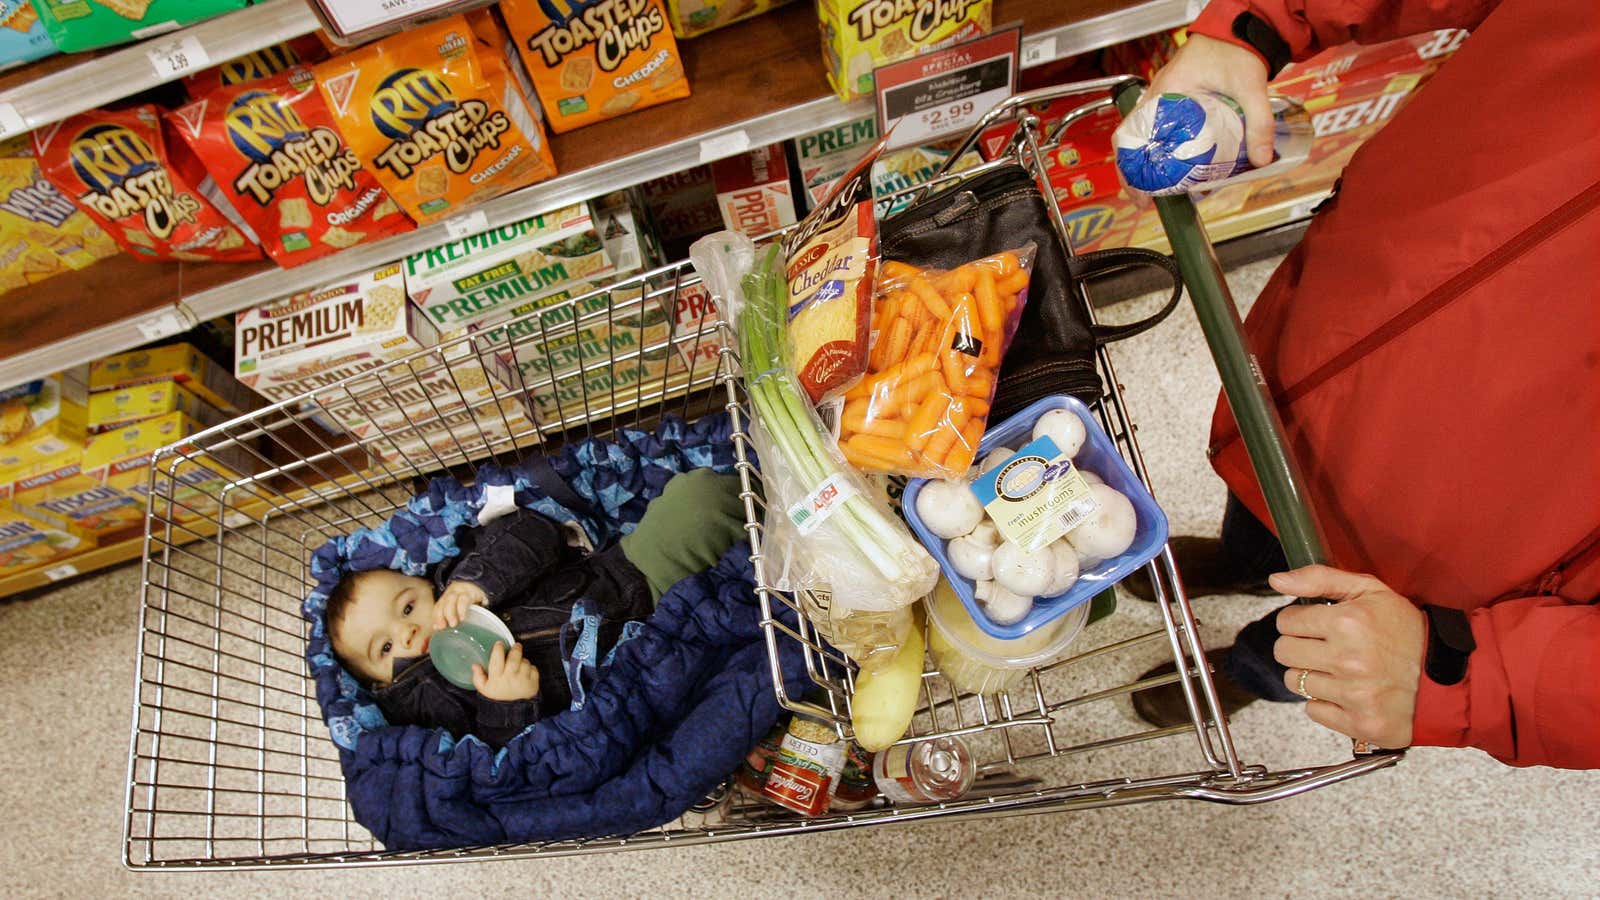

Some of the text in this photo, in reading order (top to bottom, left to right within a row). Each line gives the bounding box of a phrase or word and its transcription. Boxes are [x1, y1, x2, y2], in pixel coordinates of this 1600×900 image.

[528, 0, 647, 67] TOASTED
[596, 7, 662, 71] Chips
[613, 49, 671, 89] CHEDDAR
[921, 53, 973, 76] SPECIAL
[370, 69, 457, 134] RITZ
[922, 101, 975, 125] $2.99
[225, 95, 308, 157] RITZ
[374, 99, 489, 181] TOASTED
[445, 111, 511, 175] Chips
[800, 118, 876, 158] PREM
[70, 129, 160, 191] RITZ
[235, 128, 341, 206] TOASTED
[304, 150, 363, 207] Chips
[469, 144, 523, 185] CHEDDAR
[0, 179, 59, 220] Whe
[326, 186, 382, 226] ORIGINAL
[732, 189, 770, 238] PREM
[405, 214, 546, 277] PREMIUM
[1066, 206, 1116, 242] ITZ
[429, 261, 570, 324] PREMIUM
[458, 262, 516, 289] FAT FREE
[791, 254, 853, 297] Cheddar
[241, 298, 365, 357] PREMIUM
[516, 331, 636, 378] PREMIUM
[812, 482, 839, 513] FOXY
[1007, 511, 1025, 528] fresh
[1017, 486, 1075, 529] mushrooms
